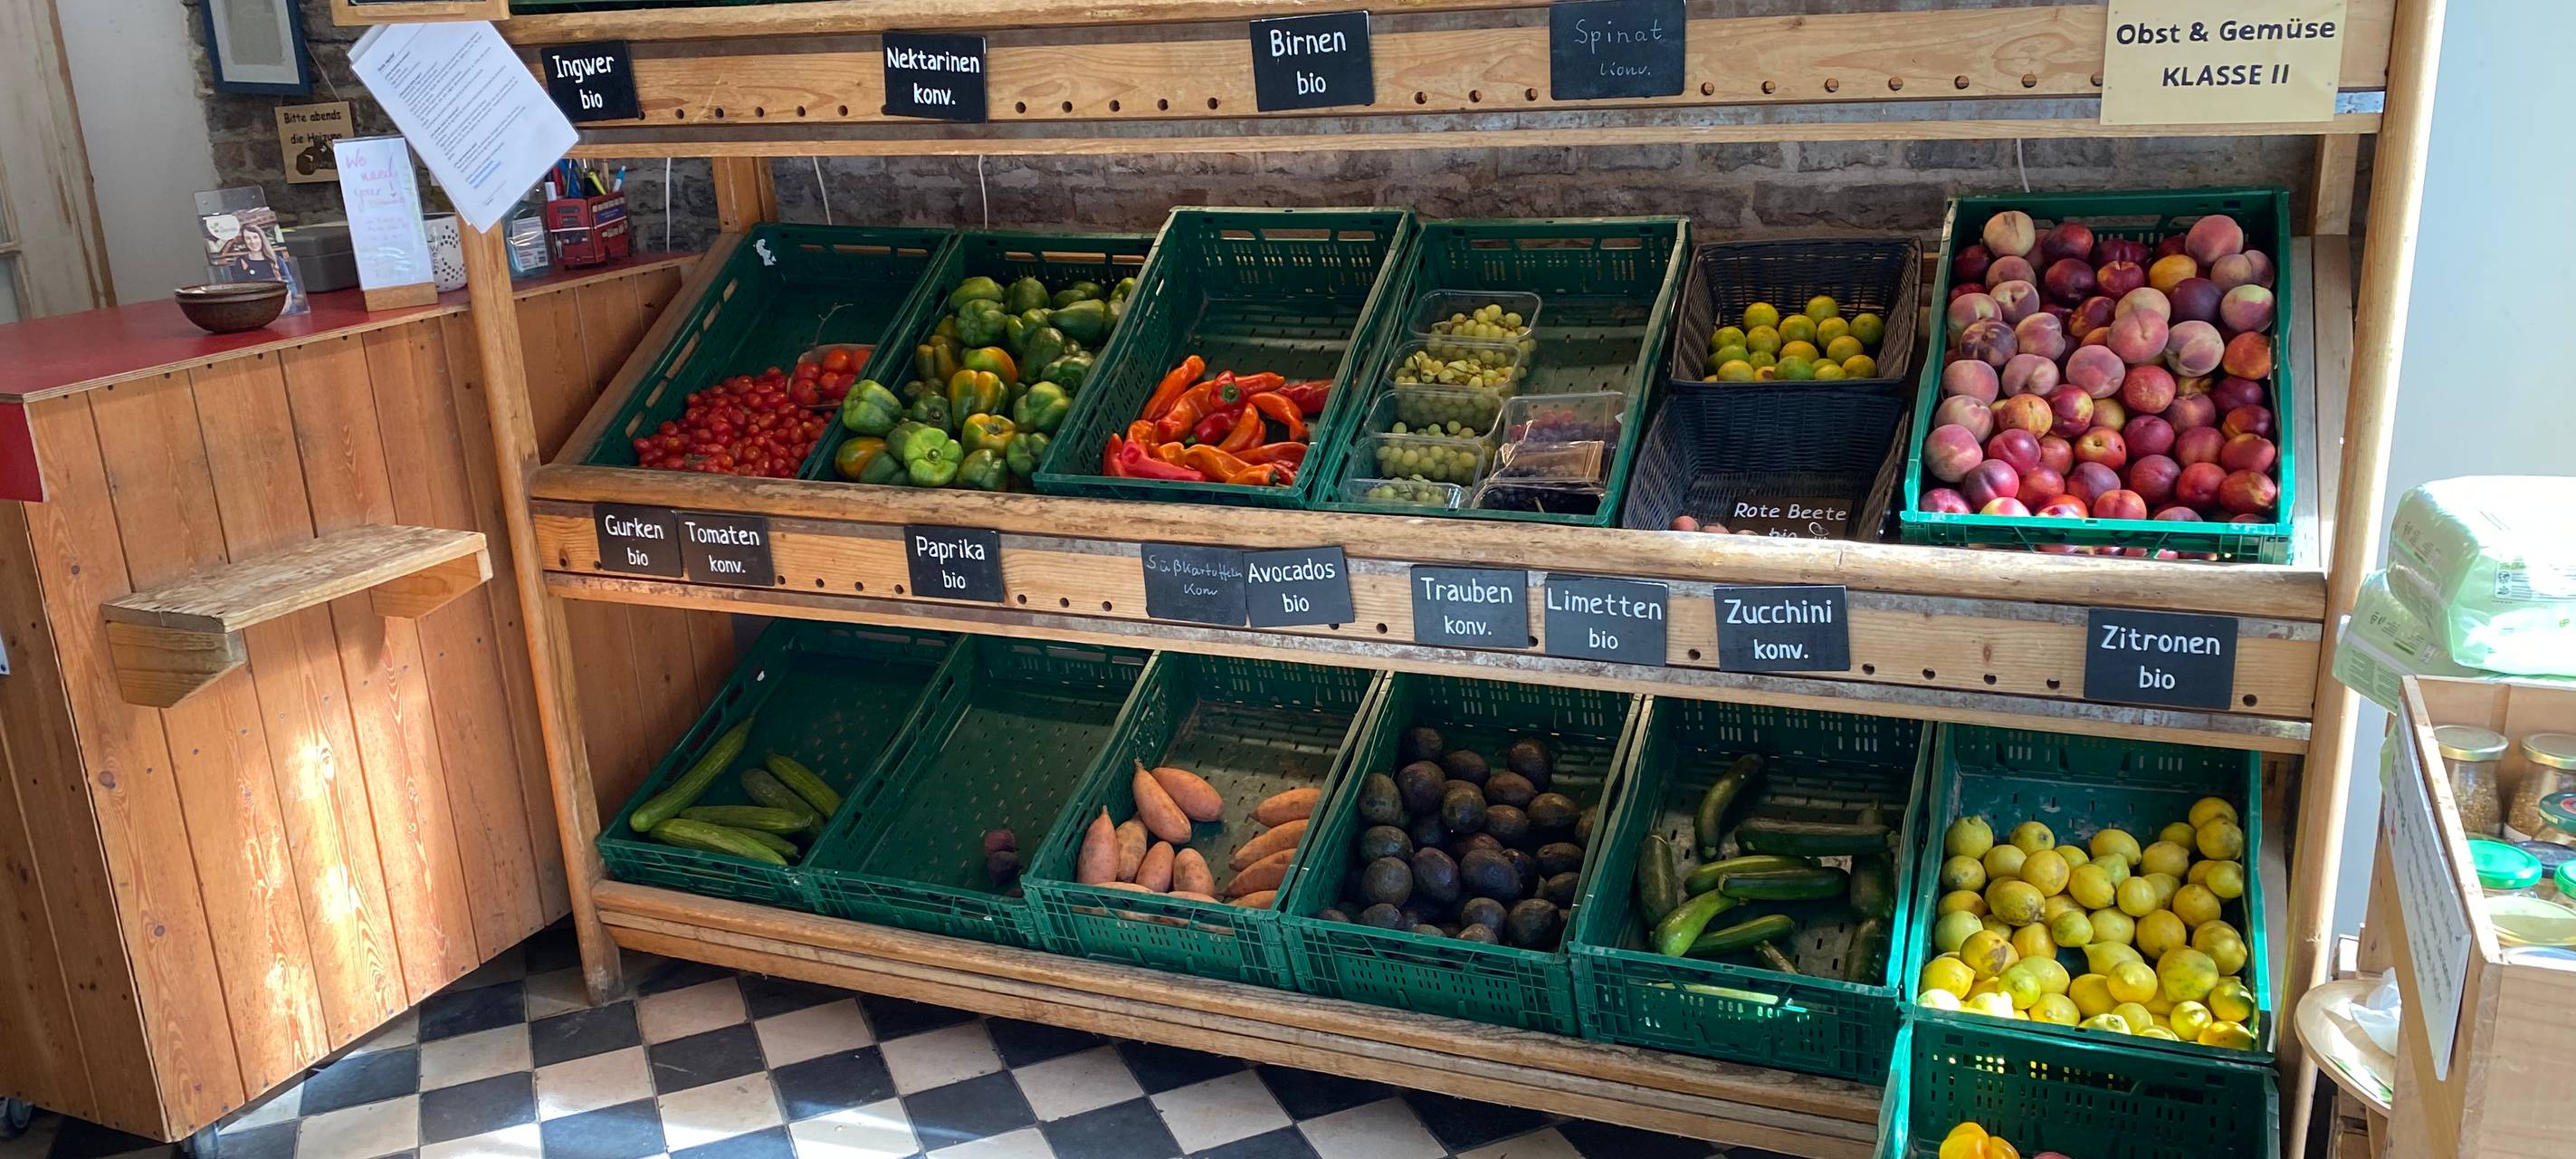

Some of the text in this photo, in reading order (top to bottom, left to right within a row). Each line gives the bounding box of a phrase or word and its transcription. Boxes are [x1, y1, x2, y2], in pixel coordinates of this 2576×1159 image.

[1574, 19, 1662, 54] Spinat
[2116, 18, 2336, 44] Obst & Gemüse
[1270, 29, 1346, 57] Birnen
[552, 55, 615, 83] Ingwer
[887, 46, 979, 72] Nektarinen
[1296, 71, 1326, 95] bio
[2162, 64, 2290, 87] KLASSE II
[579, 89, 603, 110] bio
[913, 82, 956, 105] konv.
[283, 110, 341, 124] Bitte abends
[291, 133, 303, 144] die
[1734, 502, 1846, 521] Rote Beete
[605, 514, 664, 540] Gurken
[684, 522, 760, 546] Tomaten
[626, 548, 649, 566] bio
[915, 535, 985, 565] Paprika
[709, 555, 746, 573] konv.
[1248, 558, 1336, 583] Avocados
[941, 570, 966, 589] bio
[1420, 577, 1512, 604] Trauben
[1282, 593, 1310, 612] bio
[1548, 588, 1662, 620] Limetten
[1723, 599, 1832, 624] Zucchini
[1444, 616, 1493, 636] konv.
[1589, 627, 1618, 649] bio
[1753, 639, 1808, 659] konv.
[2101, 625, 2220, 656] Zitronen
[2139, 666, 2176, 689] bio
